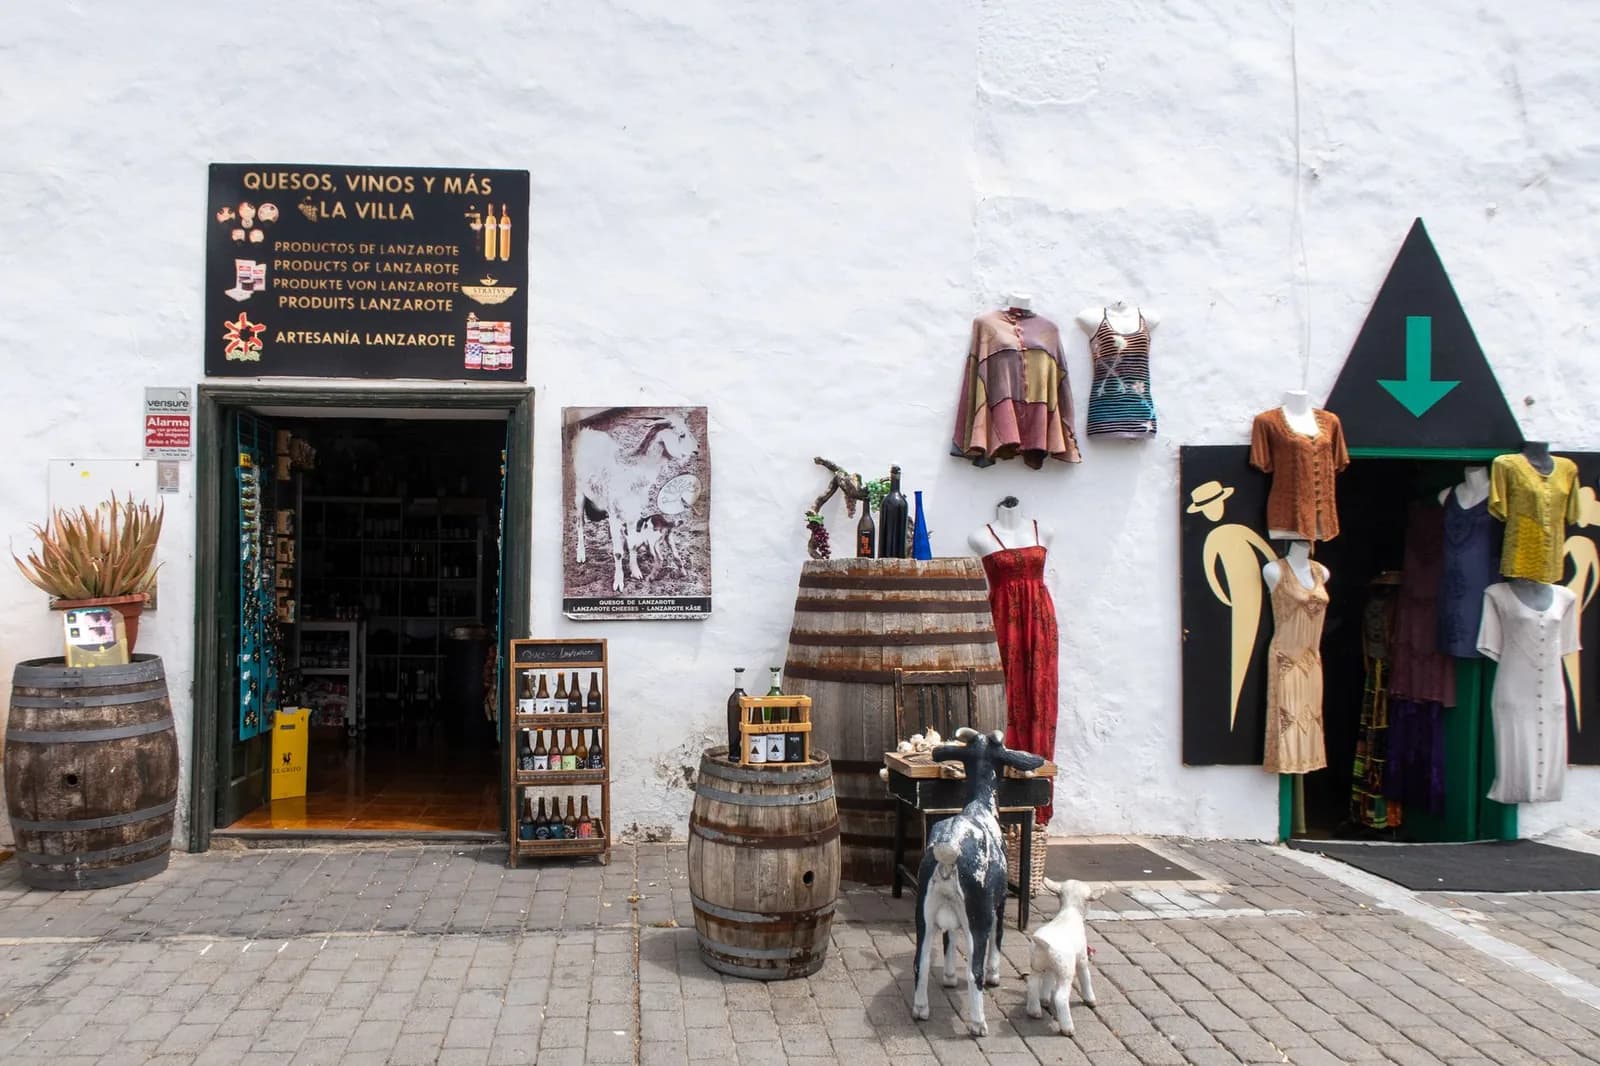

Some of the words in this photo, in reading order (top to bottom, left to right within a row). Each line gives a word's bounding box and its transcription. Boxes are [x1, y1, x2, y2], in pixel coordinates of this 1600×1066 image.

[244, 173, 337, 192] QUESOS,
[345, 174, 415, 193] VINOS
[423, 177, 435, 193] Y
[444, 174, 492, 195] MÁS
[320, 201, 346, 218] LA
[356, 202, 414, 220] VILLA
[275, 242, 355, 254] PRODUCTOS
[360, 243, 375, 255] DE
[380, 244, 459, 256] LANZAROTE
[274, 260, 347, 272] PRODUCTS
[353, 262, 370, 273] OF
[376, 262, 459, 275] LANZAROTE
[273, 278, 343, 290] PRODUKTE
[347, 280, 376, 291] VON
[381, 280, 459, 293] LANZAROTE
[279, 296, 355, 310] PRODUITS
[360, 297, 453, 312] LANZAROTE
[276, 330, 360, 345] ARTESANÍA
[365, 333, 456, 347] LANZAROTE
[147, 417, 189, 426] Alarma
